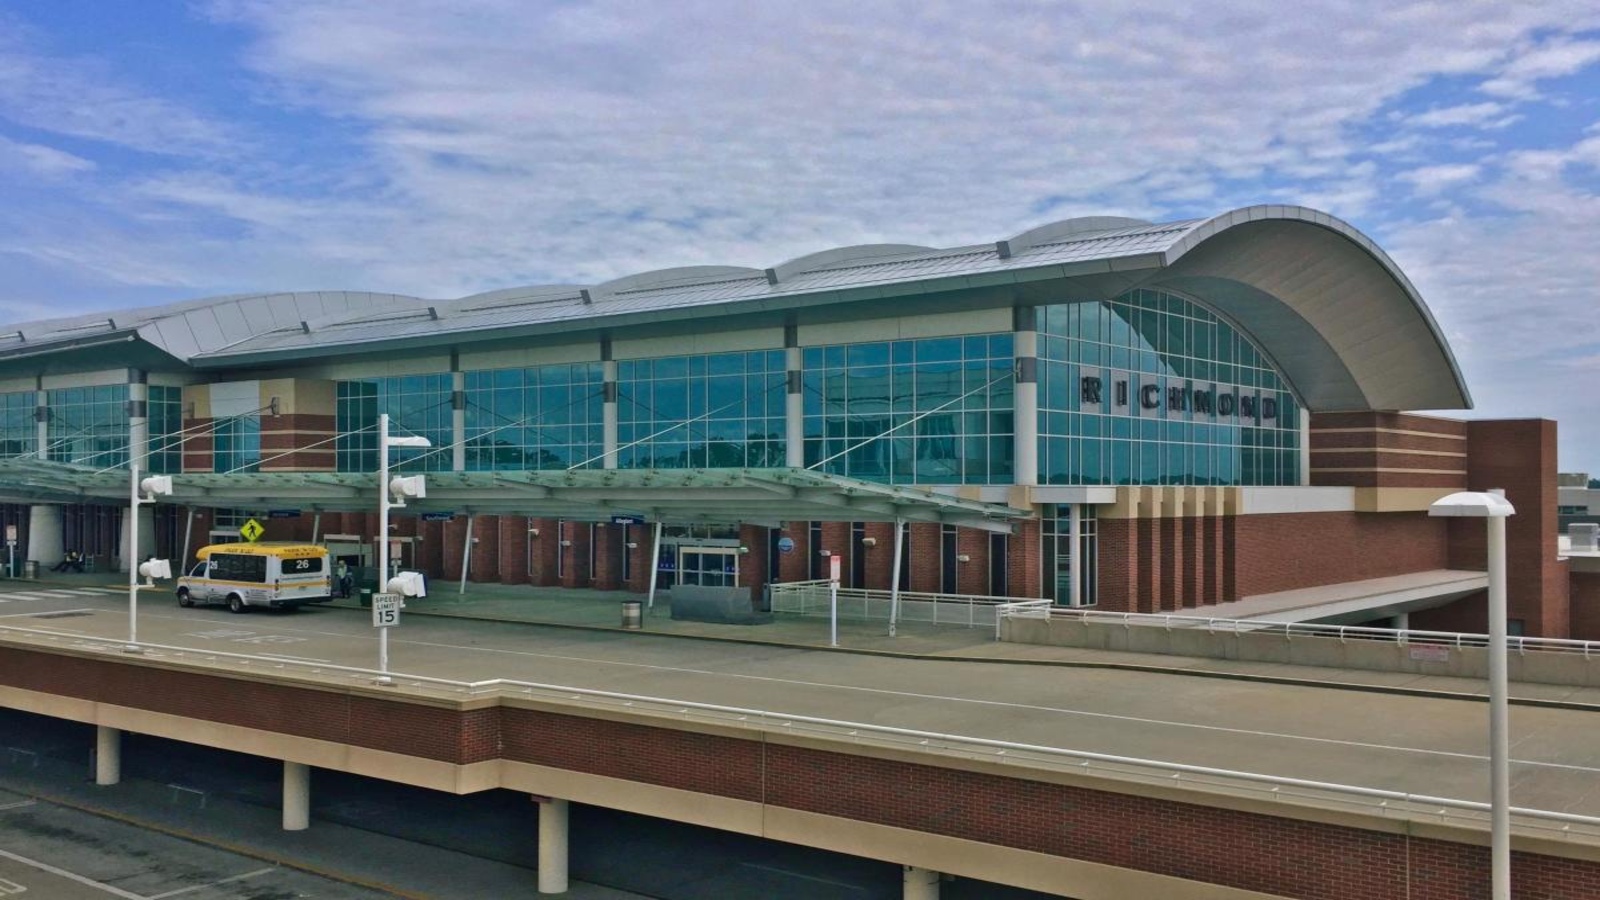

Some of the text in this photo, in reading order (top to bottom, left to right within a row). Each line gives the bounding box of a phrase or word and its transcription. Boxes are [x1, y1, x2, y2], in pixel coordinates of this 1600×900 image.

[1081, 376, 1278, 419] RICHMOND
[209, 560, 218, 570] 26
[295, 559, 310, 570] 26
[375, 595, 398, 604] SPEED
[378, 610, 396, 624] 15
